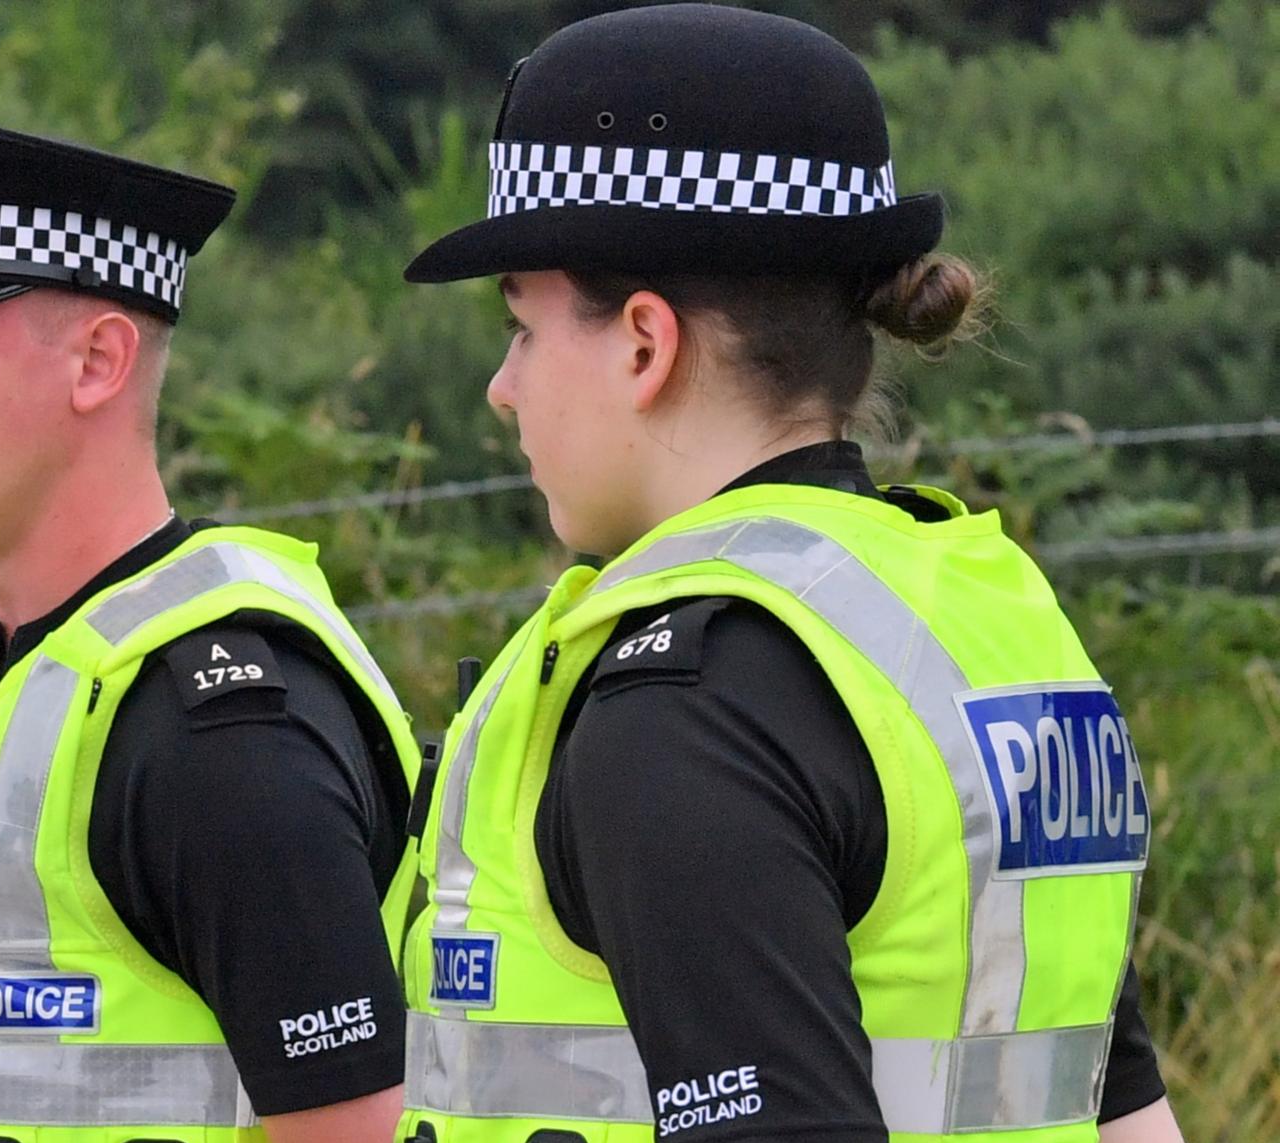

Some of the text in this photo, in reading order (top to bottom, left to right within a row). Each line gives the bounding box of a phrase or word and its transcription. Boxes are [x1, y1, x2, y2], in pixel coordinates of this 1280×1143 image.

[211, 643, 232, 661] A
[616, 629, 673, 660] 678
[193, 664, 263, 690] 1729
[985, 714, 1146, 843] POLICE
[279, 997, 374, 1041] POLICE
[284, 1021, 377, 1058] SCOTLAND
[657, 1065, 759, 1114] POLICE
[659, 1094, 762, 1137] SCOTLAND
